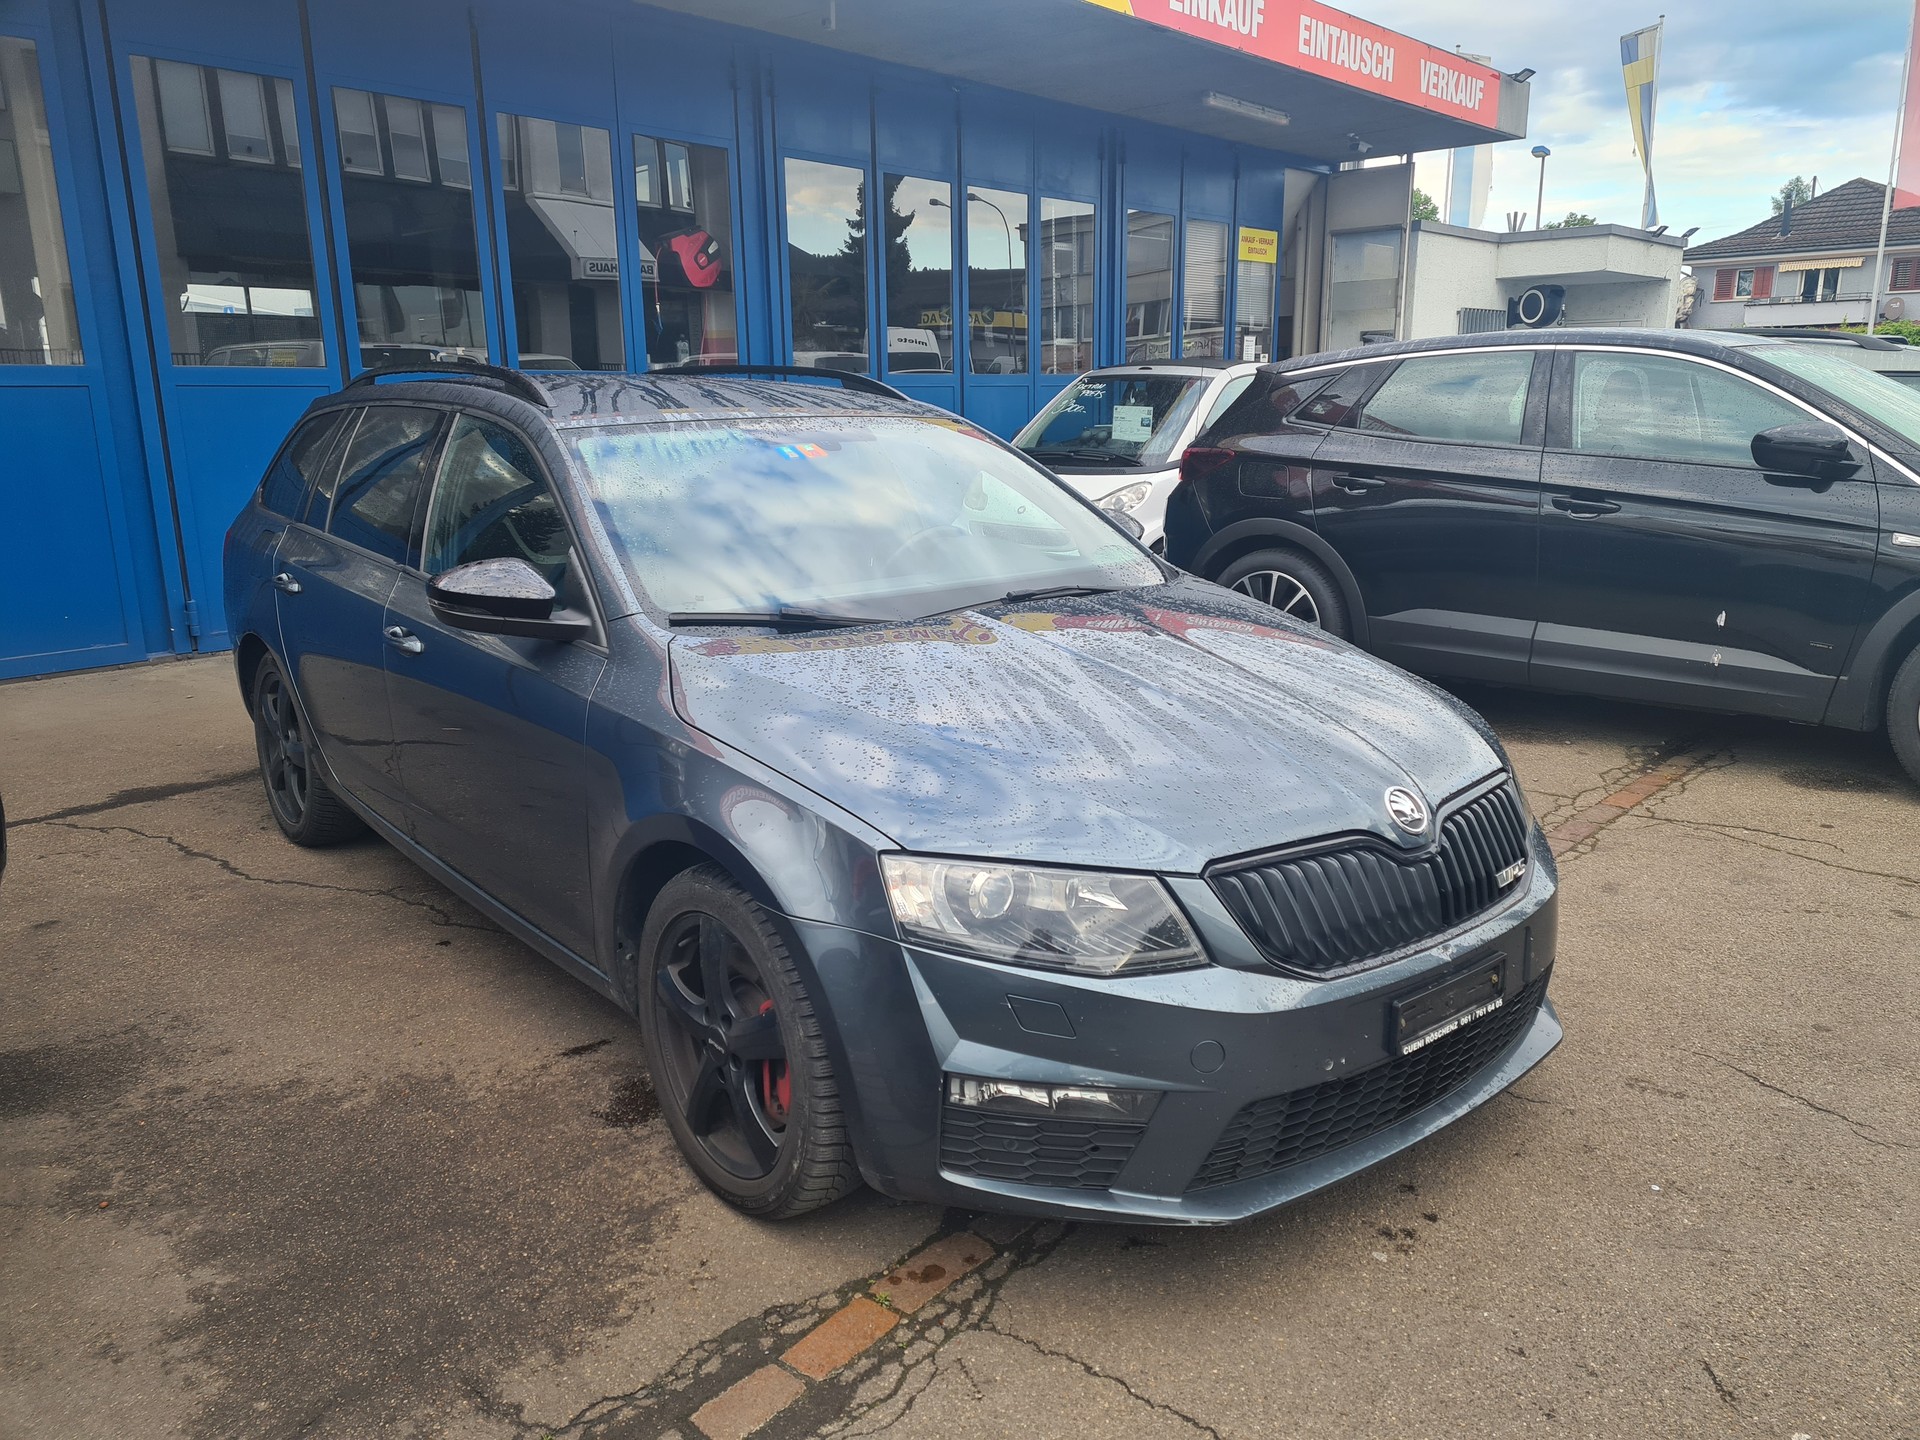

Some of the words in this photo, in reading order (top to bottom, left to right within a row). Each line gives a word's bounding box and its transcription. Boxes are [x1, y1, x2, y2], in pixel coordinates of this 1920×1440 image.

[1169, 0, 1265, 38] KAUF
[1298, 14, 1395, 83] EINTAUSCH
[1419, 58, 1485, 111] VERKAUF
[1258, 237, 1275, 246] VERKAUF
[1247, 246, 1268, 256] EINTAUSCH
